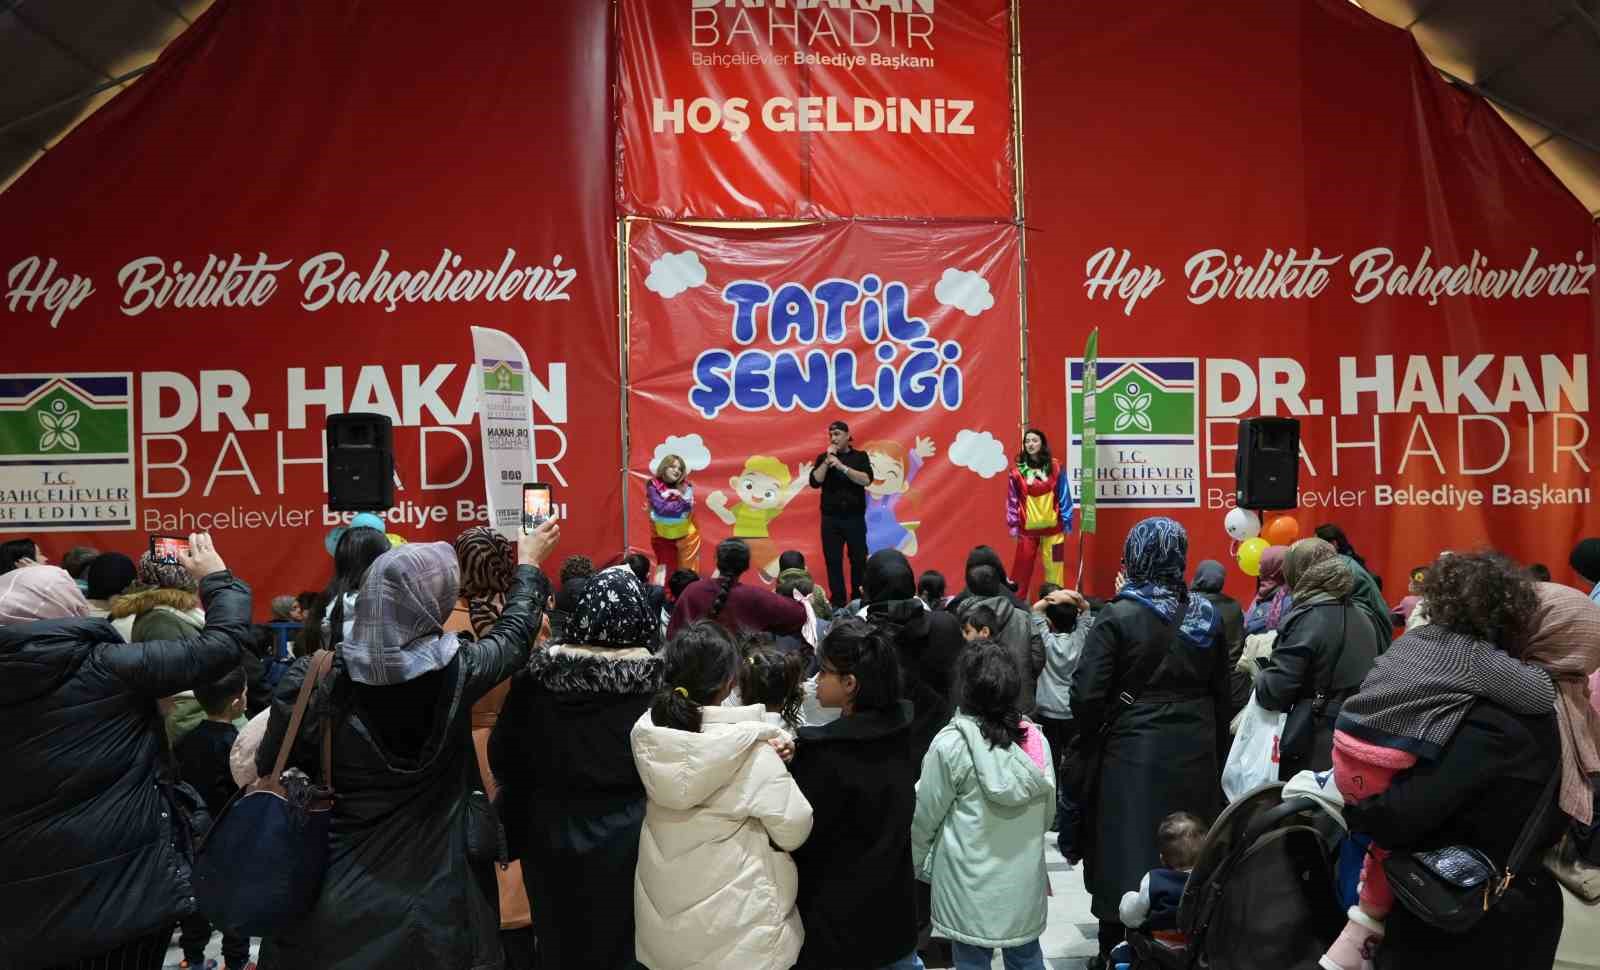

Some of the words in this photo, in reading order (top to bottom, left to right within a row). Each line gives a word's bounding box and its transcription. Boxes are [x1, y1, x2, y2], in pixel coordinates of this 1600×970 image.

[691, 8, 934, 50] BAHADIR
[794, 52, 866, 70] Belediye
[870, 53, 934, 69] Başkanı
[652, 97, 750, 141] HOŞ
[6, 256, 95, 328] Hep
[117, 251, 293, 316] Birlikte
[299, 248, 577, 312] Bahçelievleriz
[1084, 247, 1165, 316] Hep
[1184, 248, 1342, 305] Birlikte
[1349, 247, 1596, 306] Bahçelievleriz
[141, 369, 269, 433] DR.
[1205, 357, 1323, 417] DR.
[1339, 354, 1590, 415] HAKAN
[141, 423, 569, 498] BAHDR
[1119, 450, 1147, 463] T.C.
[1205, 413, 1591, 478] BHADIR
[42, 471, 75, 485] T.C.
[1074, 464, 1194, 481] BHÇELİEVLER
[1074, 483, 1194, 496] BLEDİYESİ
[323, 501, 448, 529] Bediye
[1207, 485, 1366, 509] Baievler
[1374, 484, 1484, 512] Belediye
[1492, 483, 1591, 510] Başkanı
